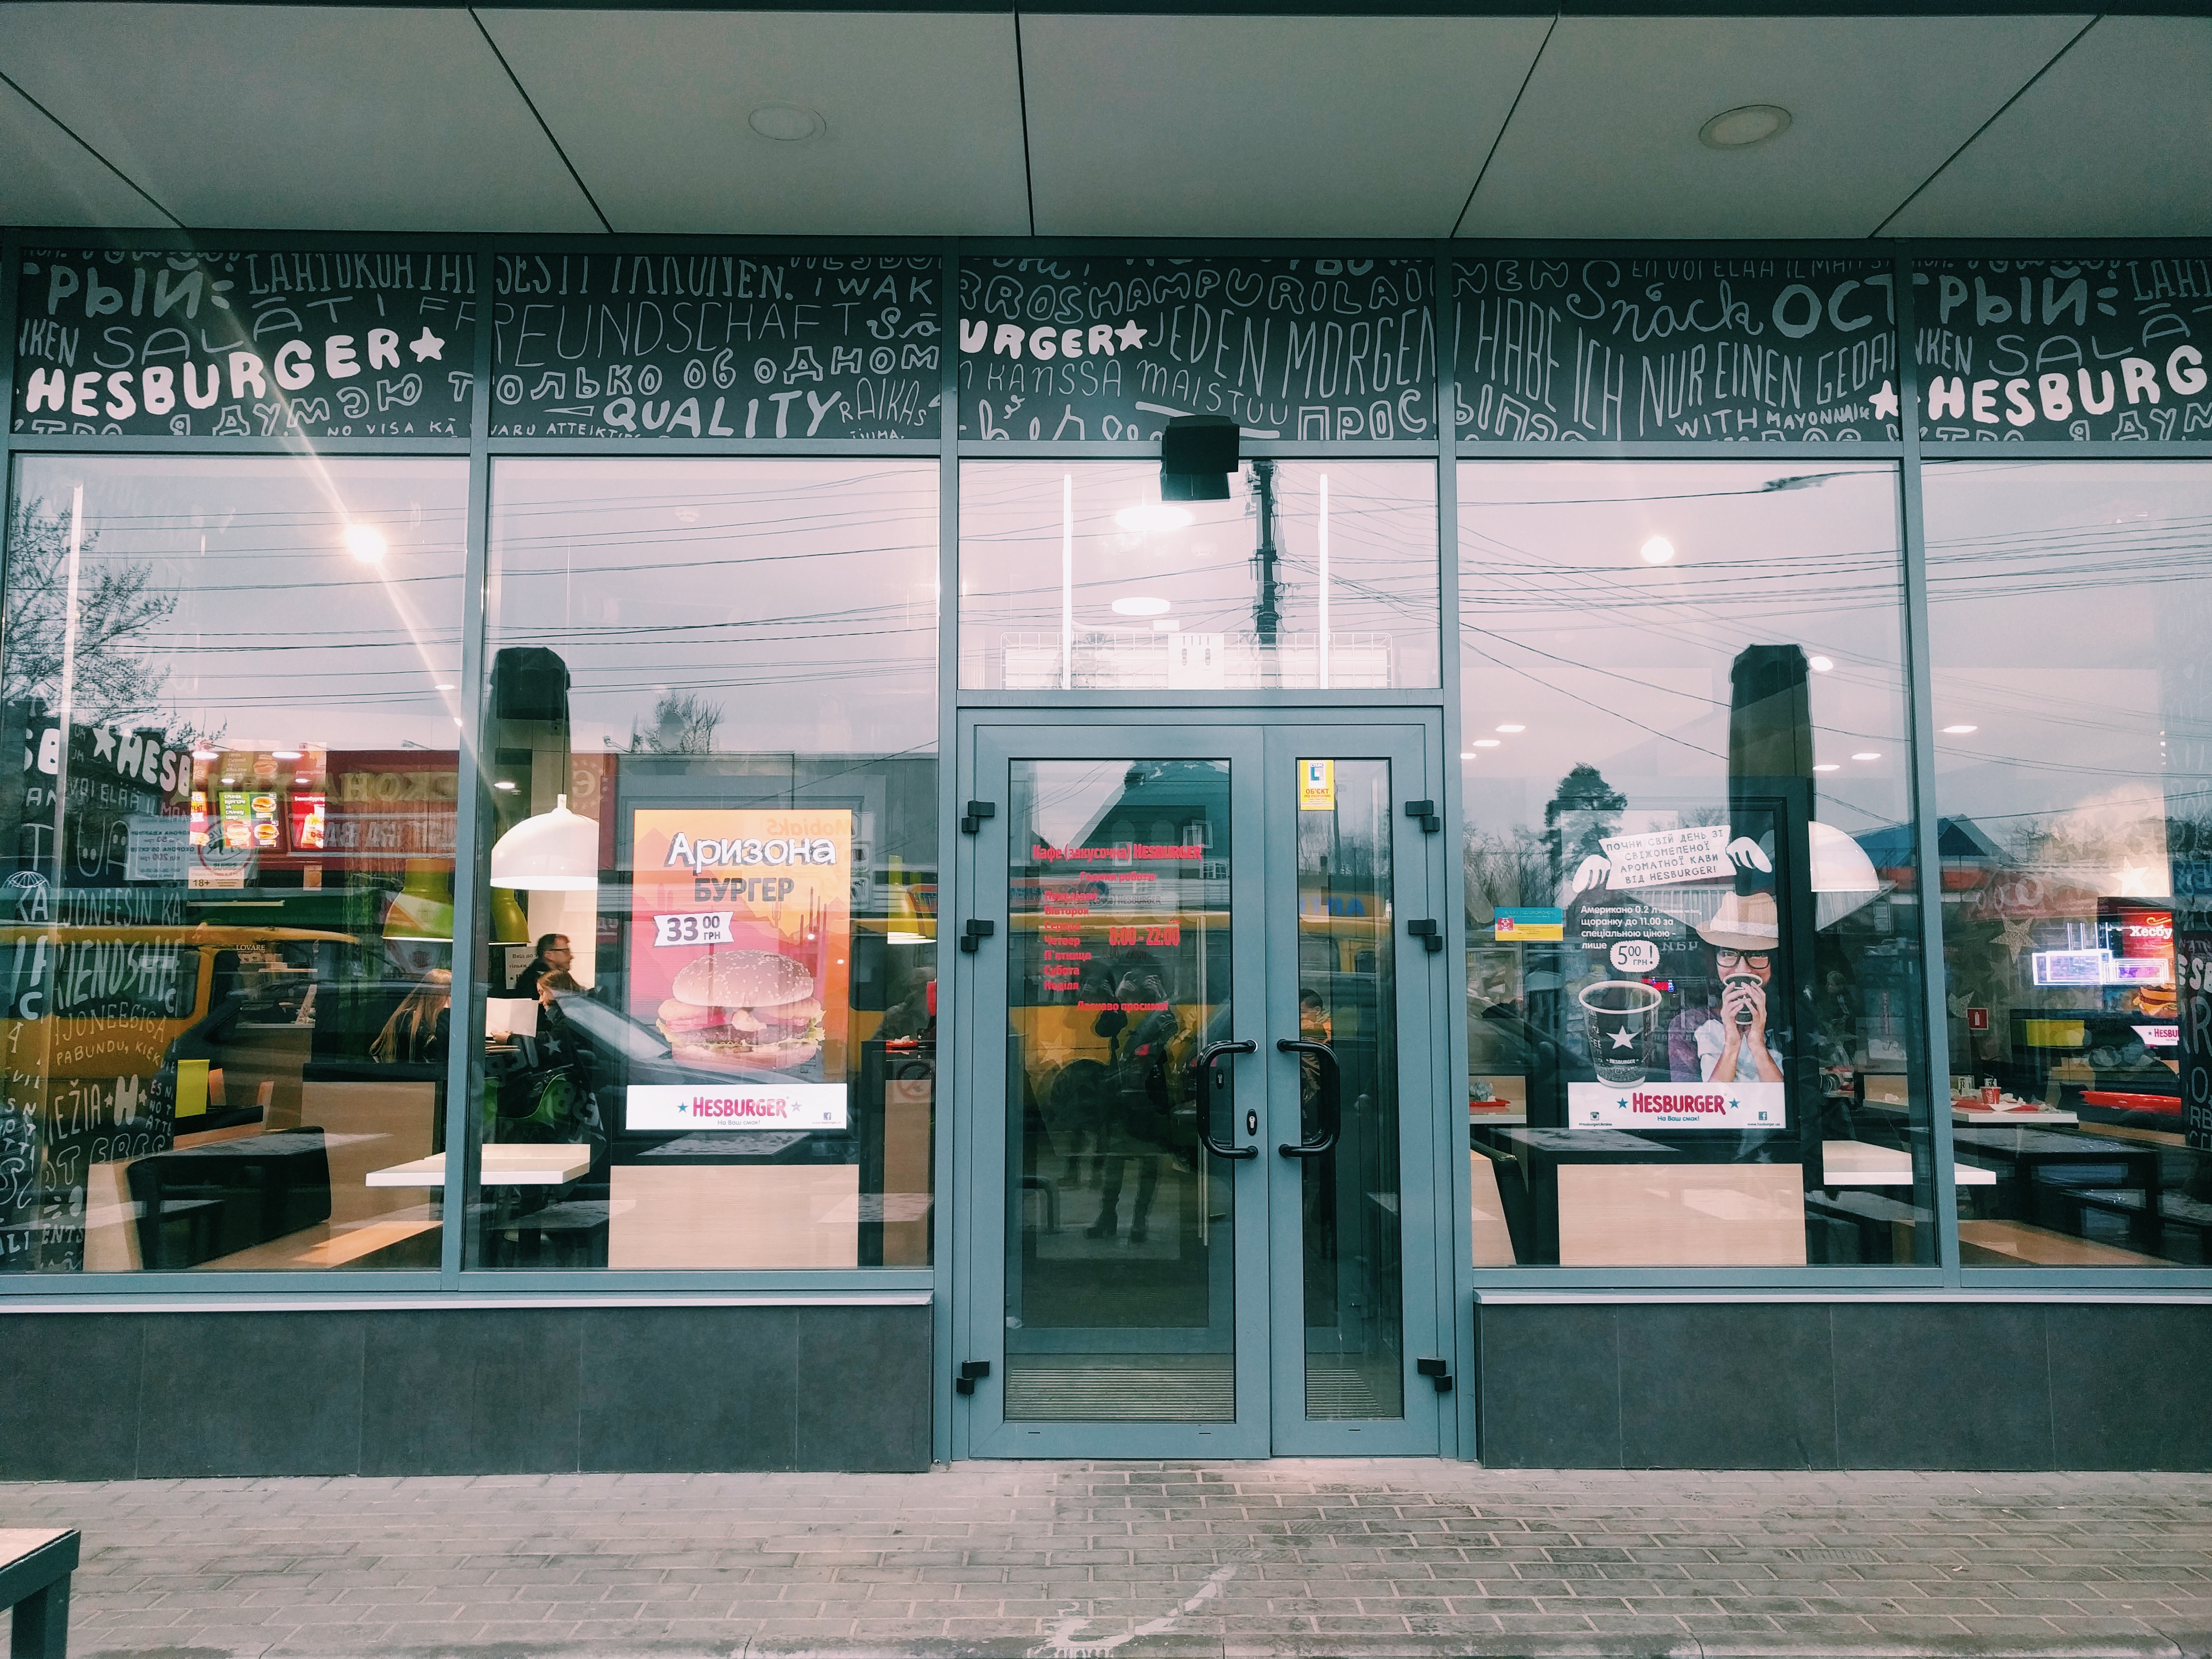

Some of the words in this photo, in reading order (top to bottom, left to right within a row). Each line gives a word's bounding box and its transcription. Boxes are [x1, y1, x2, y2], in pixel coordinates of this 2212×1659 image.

[1149, 303, 1271, 399] JEDEN
[26, 326, 401, 420] HESBURGER
[1475, 297, 1562, 413] HABE
[1573, 328, 1625, 442] ICH
[1639, 342, 1706, 439] NUR
[1715, 341, 1802, 410] EINEN
[1928, 345, 2208, 427] HESBURG
[839, 377, 927, 427] RAIKAS
[602, 390, 843, 439] QUALITY
[1674, 407, 1757, 438] WITH
[366, 420, 415, 435] VISA
[1606, 840, 1643, 851] ПОЧНИ
[1647, 833, 1674, 847] СВІЙ
[1680, 832, 1706, 843] ДЕНЬ
[1624, 840, 1711, 861] СВІЖОМЕЛЕНОЇ
[664, 832, 837, 876] Аризона
[1032, 844, 1063, 863] Кафе
[1064, 843, 1131, 863] (закусочна)
[1133, 844, 1203, 861] HESBURGER
[1620, 855, 1685, 873] АРОМАТНОЇ
[1690, 853, 1719, 864] КАВИ
[193, 879, 210, 887] 18+
[1626, 875, 1645, 884] ВІД
[1649, 865, 1717, 881] HESBURGER!
[695, 877, 795, 902] БУРГЕР
[1044, 905, 1089, 917] Вівторок
[1581, 905, 1633, 916] Американо
[1635, 905, 1649, 913] 0.2
[667, 917, 698, 941] 33
[703, 916, 720, 929] 00
[1044, 921, 1081, 932] Середа
[1581, 919, 1623, 927] щоранку
[703, 932, 721, 940] ГРН
[1044, 935, 1081, 947] Четвер
[1109, 927, 1137, 946] 8:00
[1146, 927, 1181, 946] 22:00
[1581, 929, 1641, 939] спеціальною
[1643, 929, 1670, 939] ціною
[1044, 964, 1080, 977] Субота
[1044, 980, 1080, 991] Неділя
[693, 1096, 787, 1119] HESBURGER
[1632, 1092, 1726, 1115] HESBURGER
